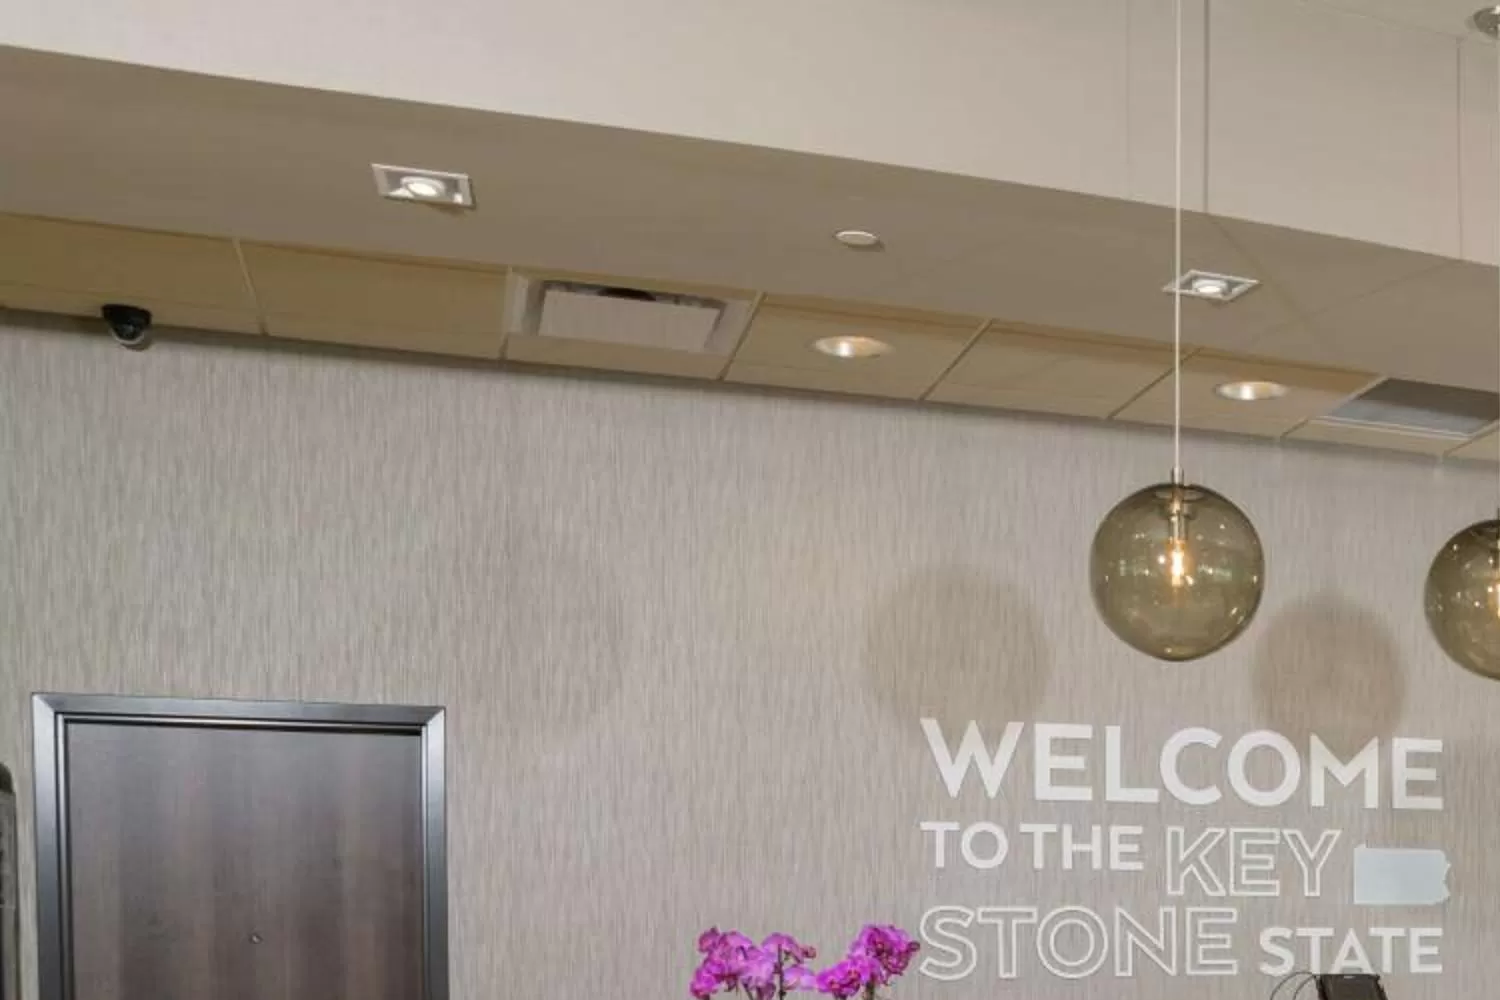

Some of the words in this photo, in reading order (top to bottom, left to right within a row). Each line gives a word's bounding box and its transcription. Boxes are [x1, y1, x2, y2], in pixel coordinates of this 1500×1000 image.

[920, 717, 1443, 809] WELCOME
[920, 821, 1009, 869] TO
[1020, 823, 1144, 870] THE
[1166, 826, 1341, 897] KEY
[920, 905, 1238, 980] STONE
[1259, 926, 1443, 976] STATE
